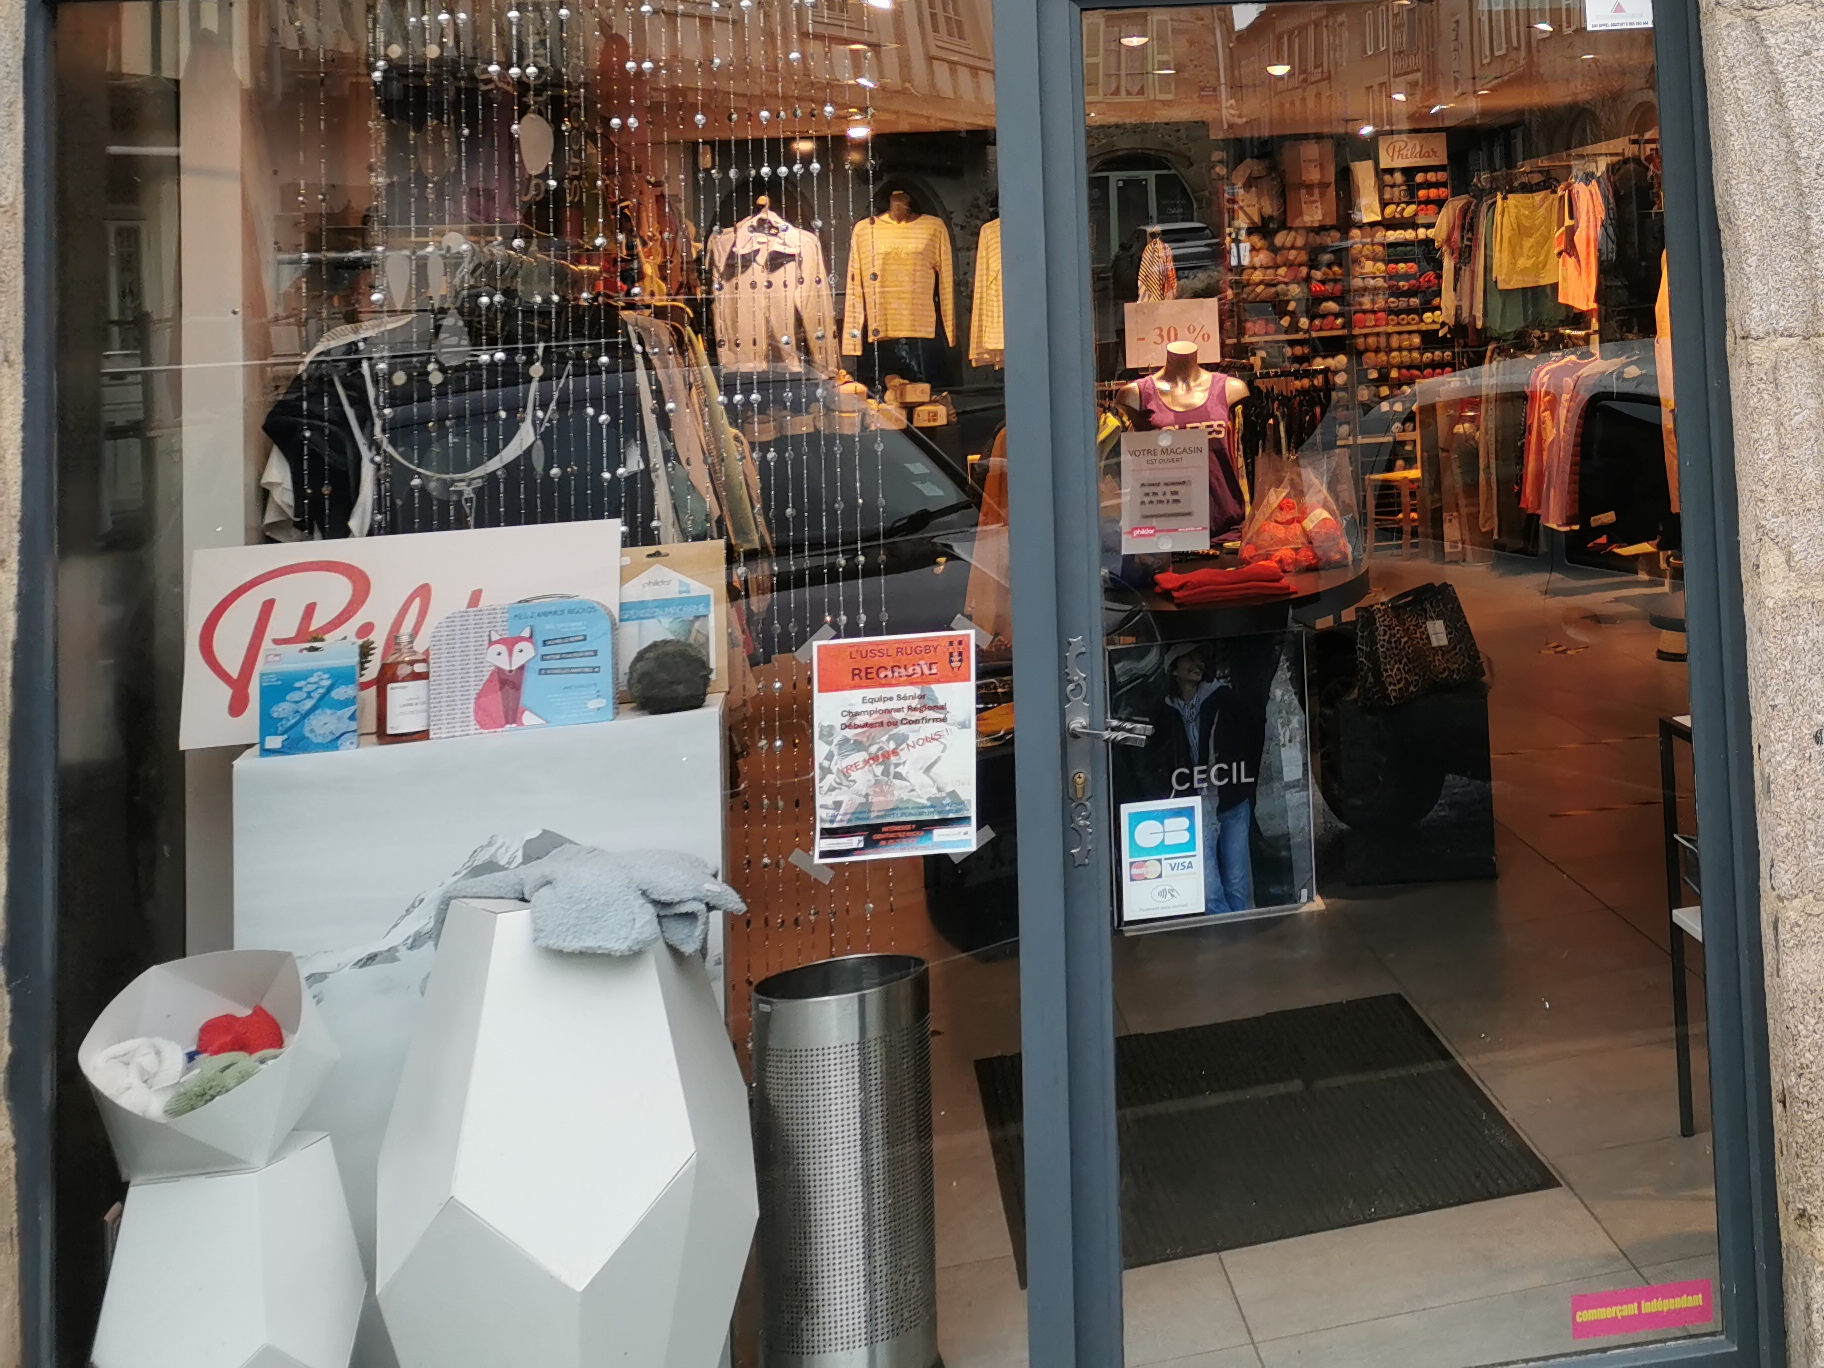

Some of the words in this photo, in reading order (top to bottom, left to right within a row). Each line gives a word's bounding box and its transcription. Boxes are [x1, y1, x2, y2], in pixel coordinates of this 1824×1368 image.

[1386, 139, 1439, 163] Phildar
[1128, 448, 1158, 458] VOTRE
[1160, 446, 1203, 456] MAGASIN
[1158, 457, 1183, 465] OUVERT
[850, 648, 892, 660] L'USSL
[896, 644, 940, 657] RUGBY
[851, 662, 939, 681] RECRUTE
[861, 695, 894, 705] Equipe
[896, 693, 927, 702] Sénior
[841, 706, 904, 718] Championnat
[907, 703, 947, 713] Régional
[900, 713, 948, 726] Confirmé
[1171, 760, 1254, 791] CECIL
[1169, 860, 1193, 872] VISA
[1576, 1302, 1638, 1323] commerçant
[1641, 1293, 1703, 1315] indépendant
